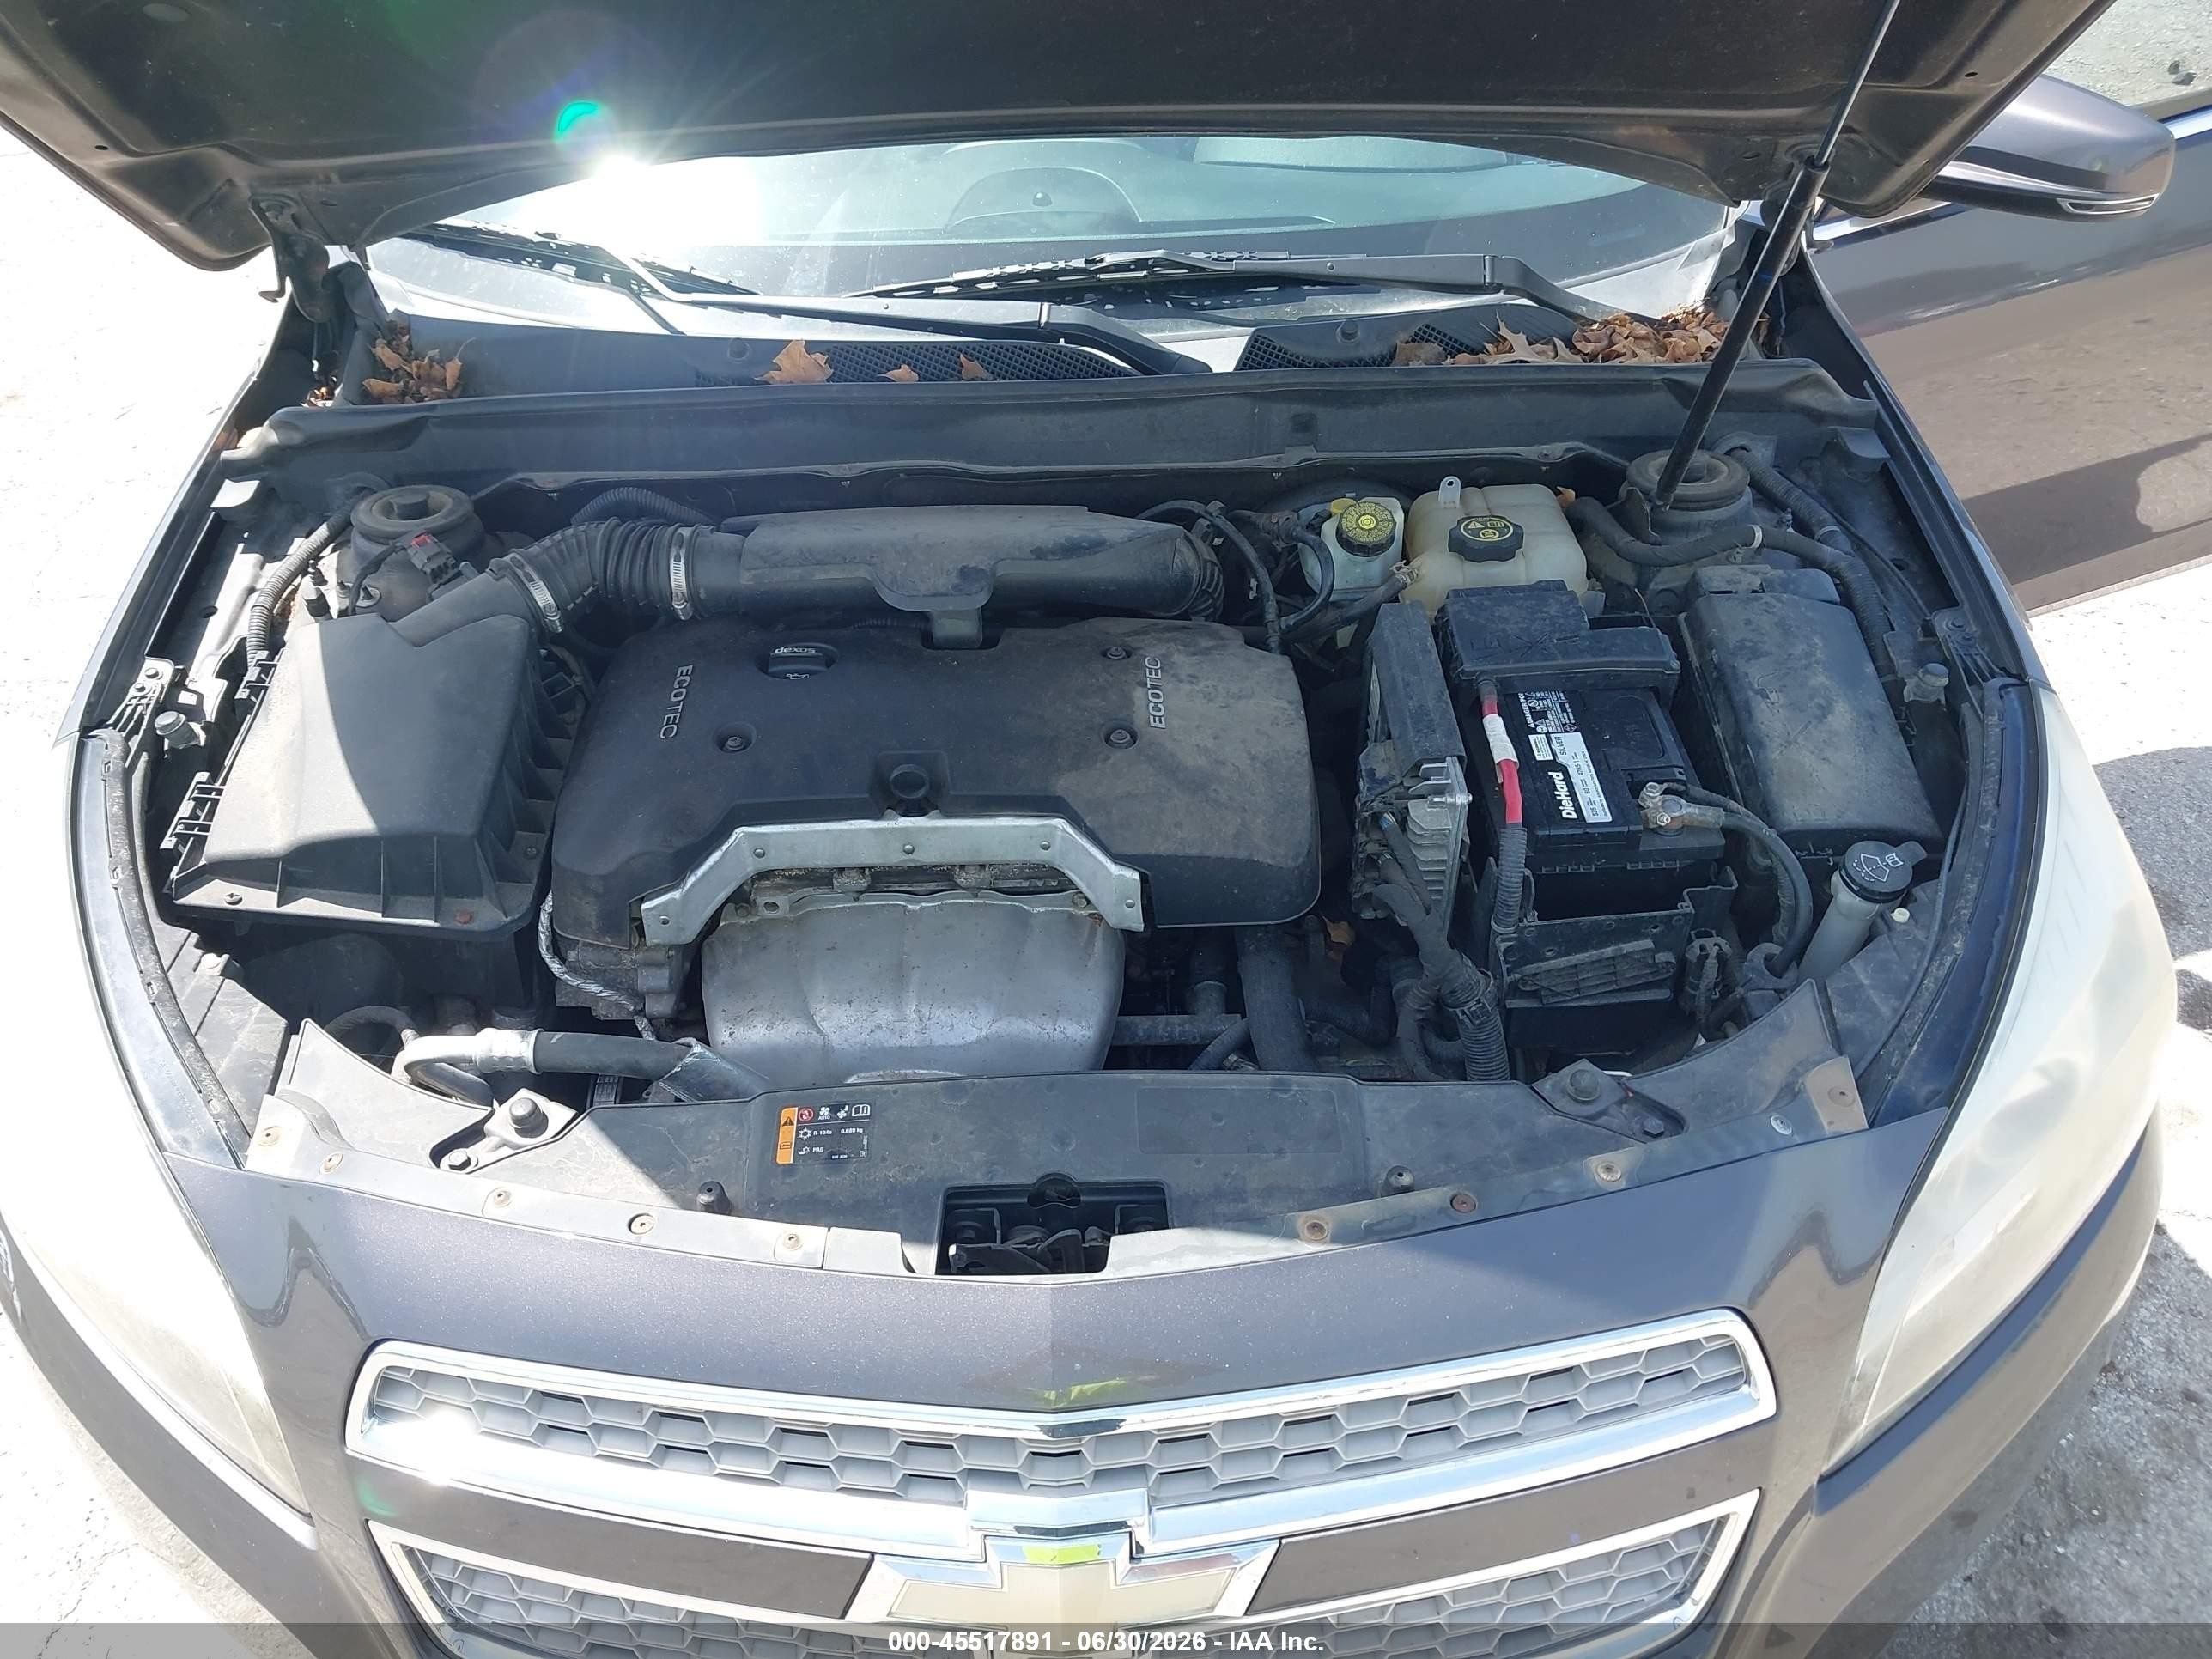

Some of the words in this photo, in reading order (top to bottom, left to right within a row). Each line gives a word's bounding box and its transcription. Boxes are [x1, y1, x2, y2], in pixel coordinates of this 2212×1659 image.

[659, 665, 694, 739] ECOTEC
[1145, 656, 1166, 729] ECOTEC
[1553, 736, 1567, 756] SILVER
[1547, 771, 1578, 820] DieHard
